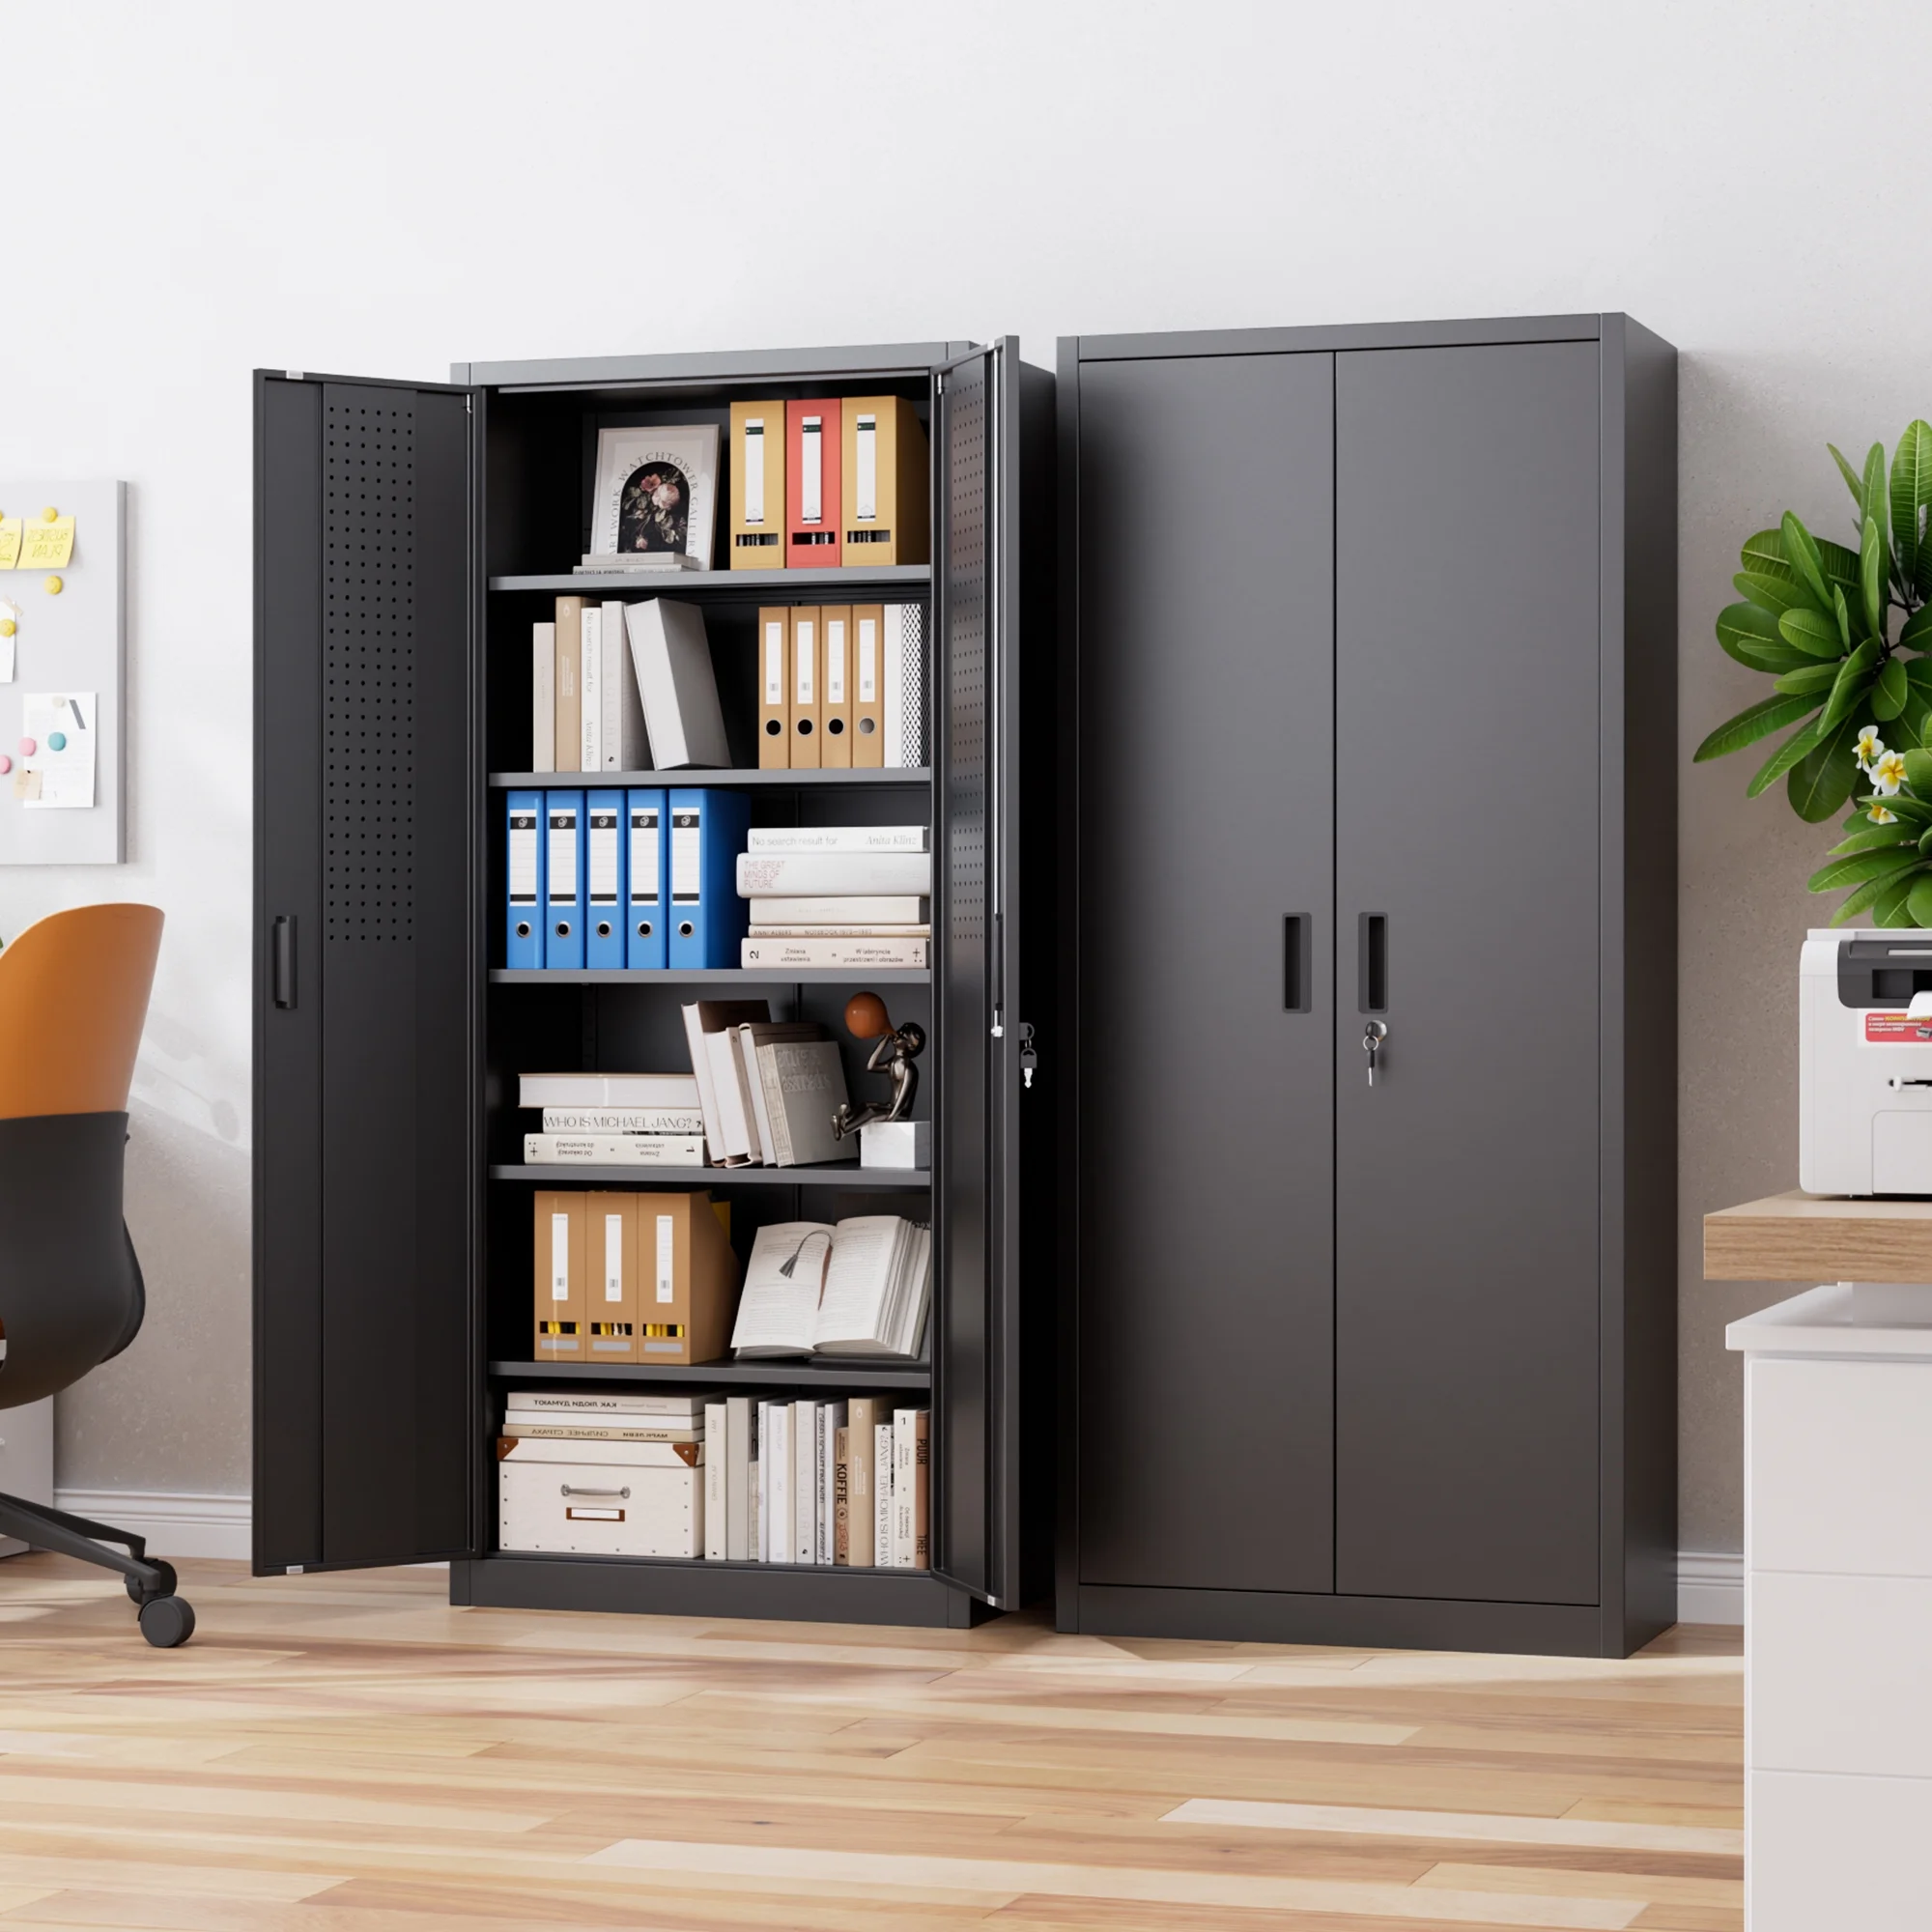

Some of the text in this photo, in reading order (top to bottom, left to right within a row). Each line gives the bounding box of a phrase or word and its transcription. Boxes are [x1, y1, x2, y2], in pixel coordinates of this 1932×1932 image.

[618, 451, 698, 491] WATCHTOWER
[752, 836, 918, 846] No search result for Anita Klinz
[744, 861, 785, 869] THE GREAT
[744, 870, 768, 879] MINDS
[744, 879, 774, 888] FUTURE
[750, 951, 759, 959] 2
[544, 1117, 692, 1129] WHO IS MICHAEL JANG?
[917, 1438, 927, 1464] PUUR
[837, 1463, 847, 1505] KOFFIE
[880, 1435, 889, 1566] WHO IS MICHAEL JANG?
[917, 1534, 927, 1556] THEE
